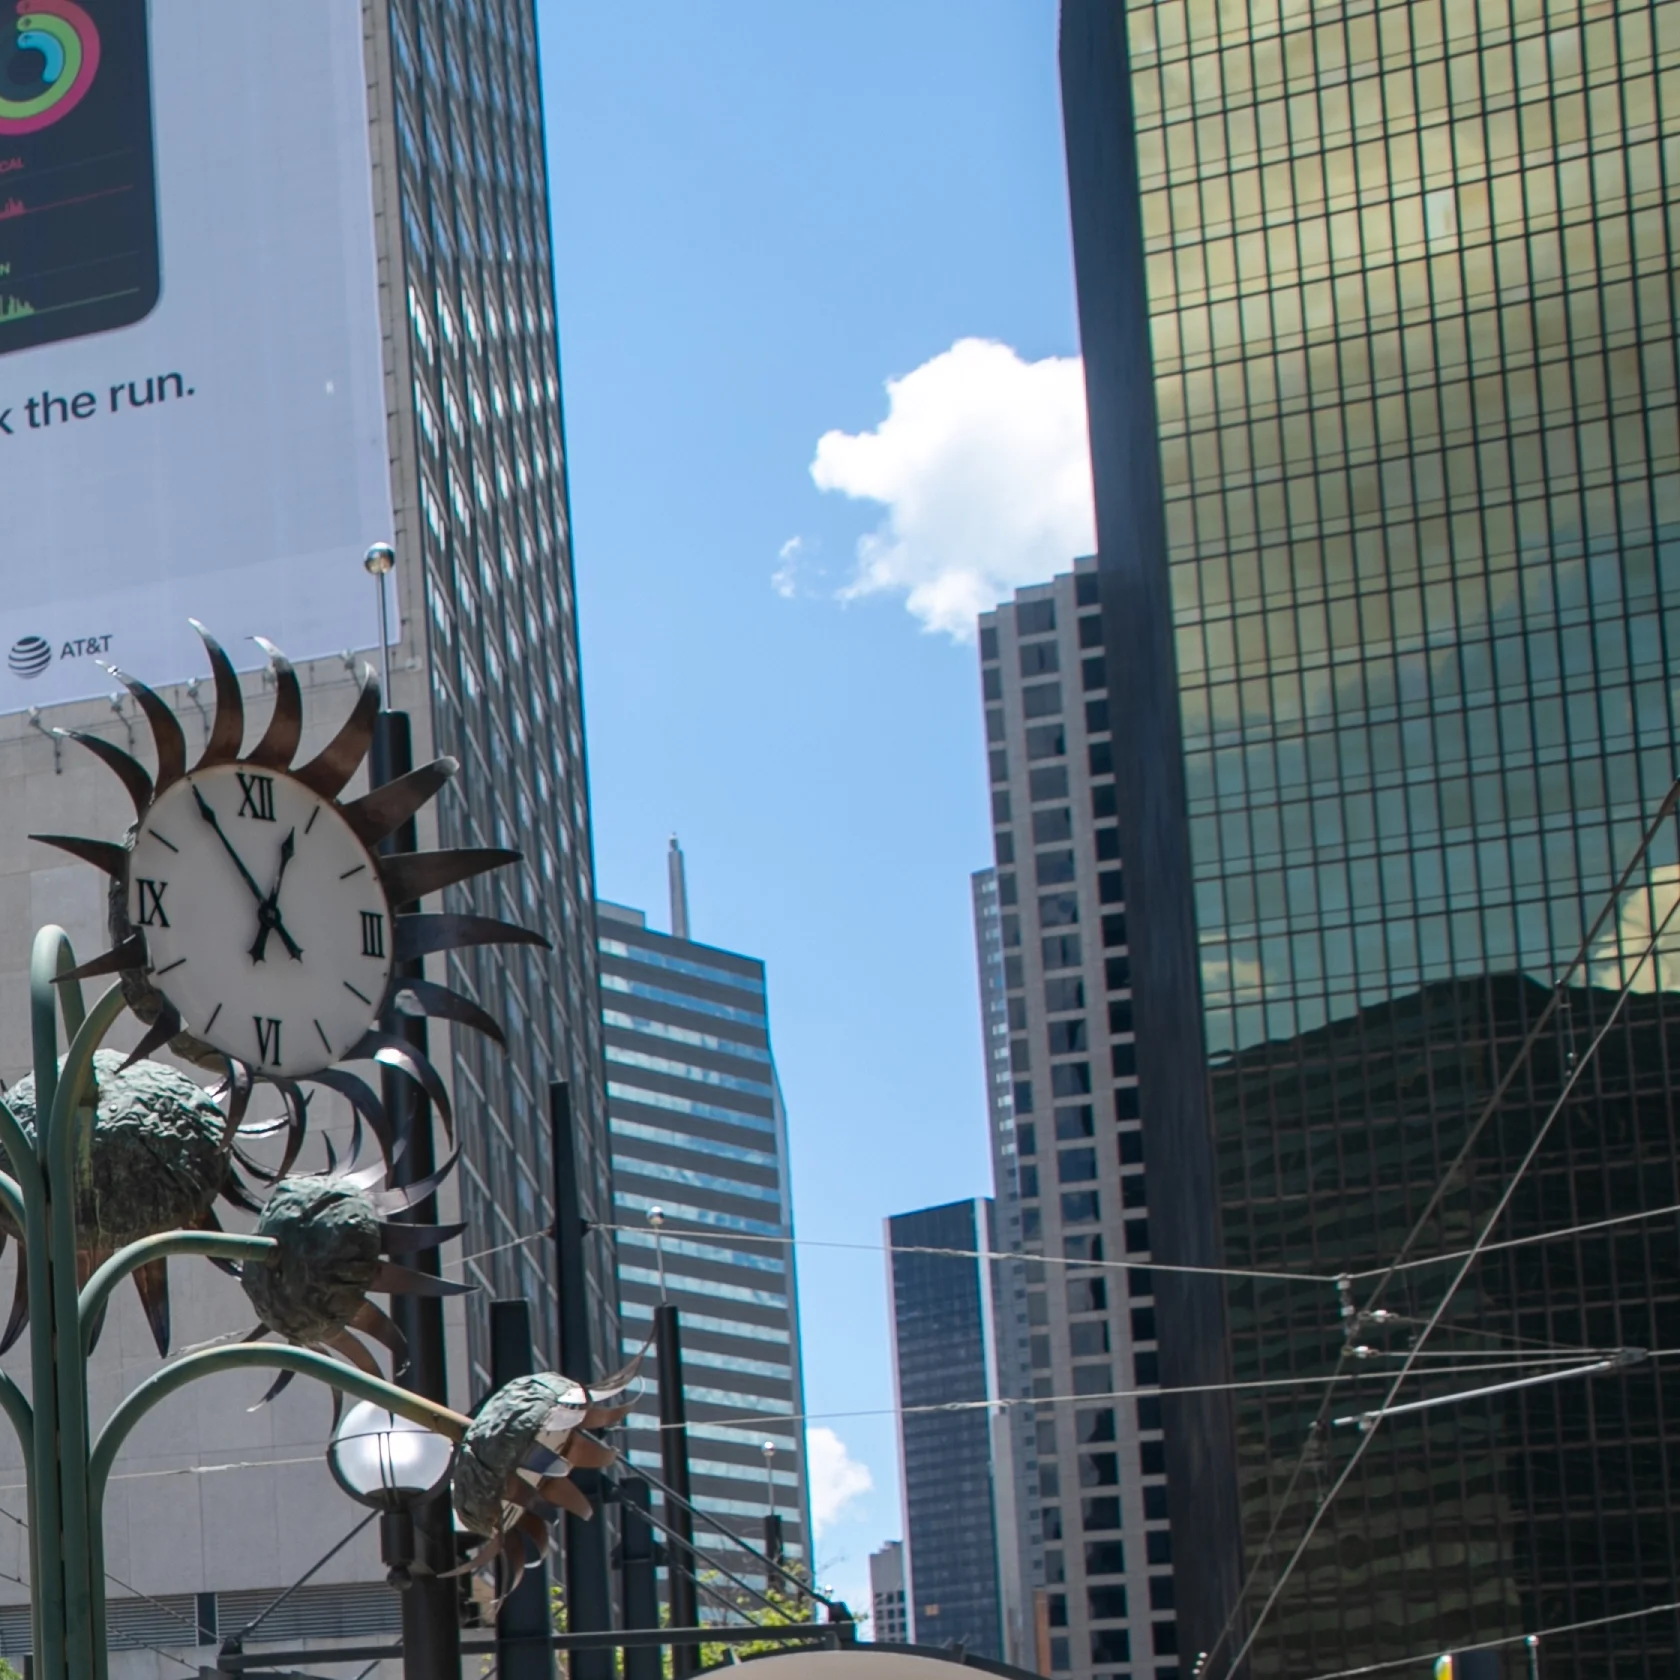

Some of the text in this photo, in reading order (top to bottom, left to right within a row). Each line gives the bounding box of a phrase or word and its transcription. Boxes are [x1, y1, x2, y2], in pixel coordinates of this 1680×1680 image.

[24, 391, 97, 429] the
[109, 372, 196, 414] run.
[60, 634, 114, 661] AT&T
[235, 772, 277, 822] XII
[136, 878, 171, 928] IX
[359, 910, 386, 959] III
[252, 1015, 282, 1066] VI
